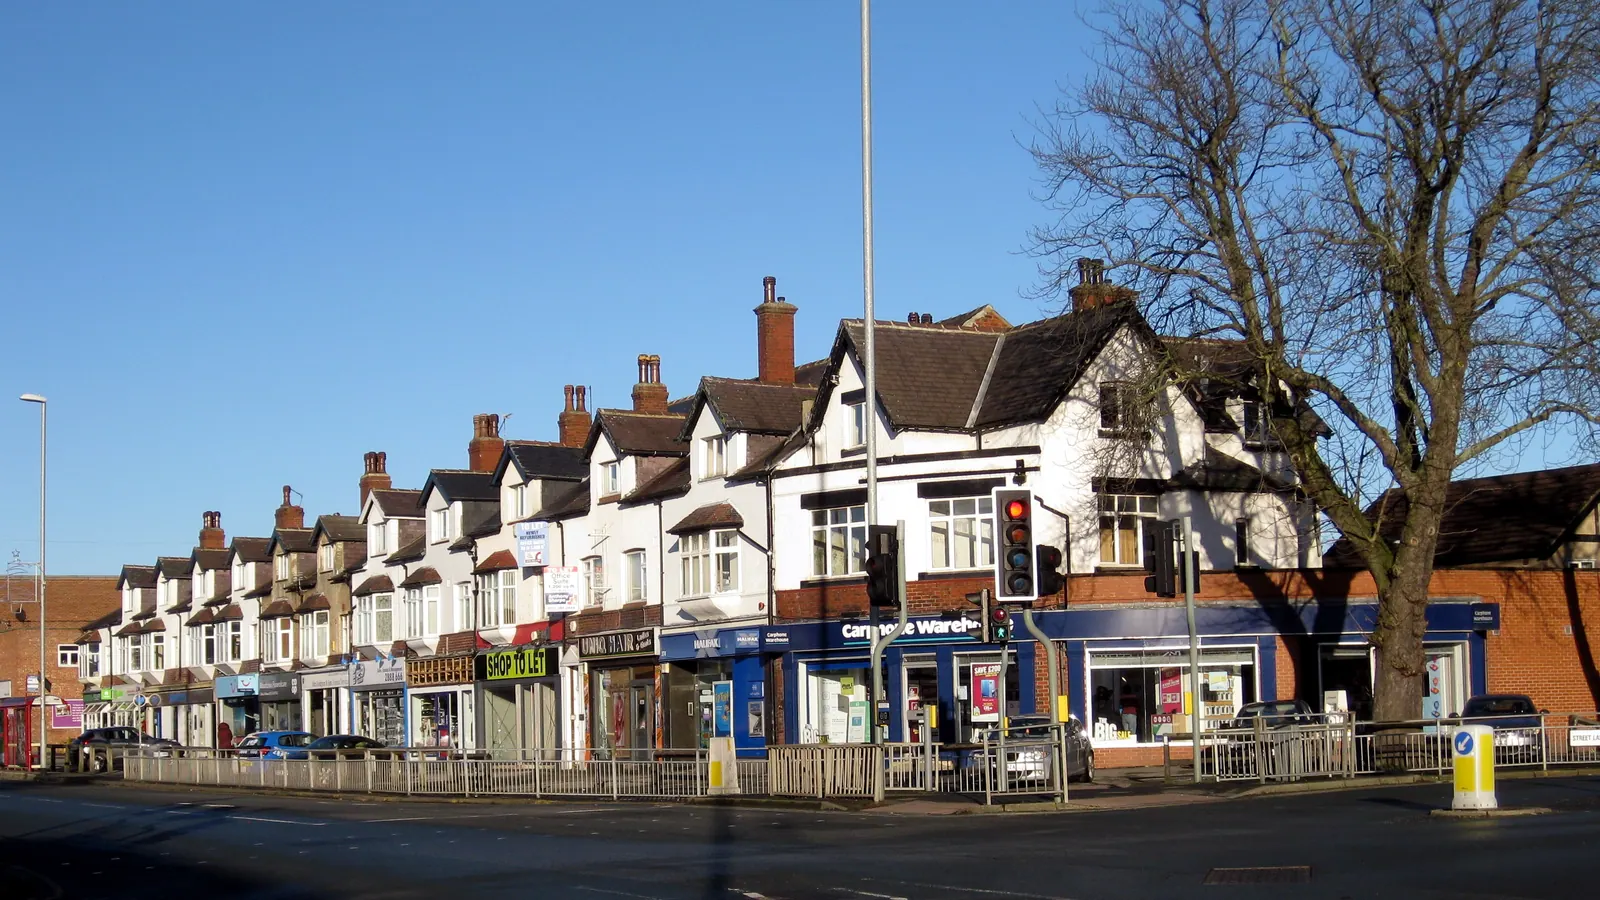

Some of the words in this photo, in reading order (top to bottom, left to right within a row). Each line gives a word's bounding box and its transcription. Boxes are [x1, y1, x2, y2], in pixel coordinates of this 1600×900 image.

[842, 623, 915, 639] Caroe
[582, 636, 607, 655] UNIQ
[608, 633, 634, 653] HAIR
[694, 637, 721, 649] HALIFAX
[488, 654, 511, 677] SHOP
[514, 652, 525, 675] TO
[528, 651, 545, 674] LET
[974, 666, 987, 675] SAVE
[803, 727, 820, 744] BIG
[1095, 722, 1117, 741] BIG
[1117, 730, 1131, 739] SALE
